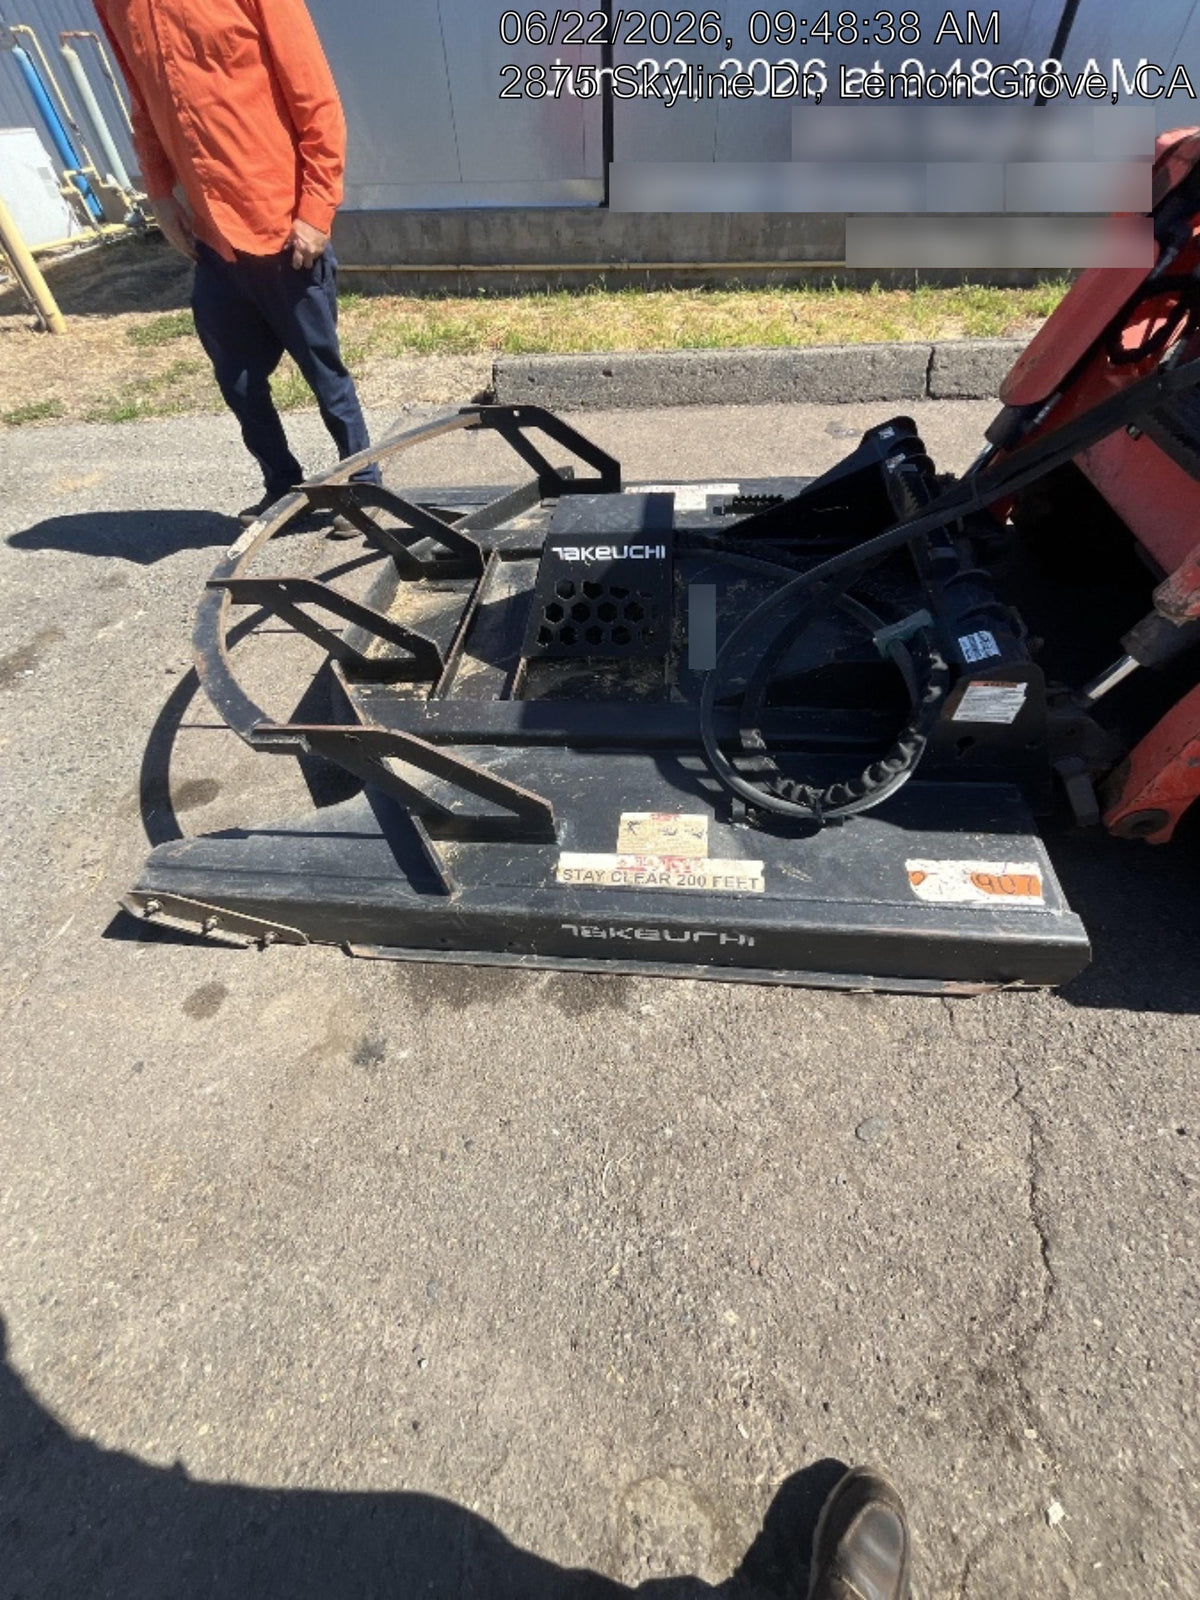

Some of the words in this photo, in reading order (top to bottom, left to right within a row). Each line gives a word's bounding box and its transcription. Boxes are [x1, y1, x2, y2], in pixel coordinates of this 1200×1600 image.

[563, 869, 605, 882] STAY
[611, 870, 672, 886] CLEAR
[677, 873, 707, 889] 200
[712, 876, 760, 891] FEET
